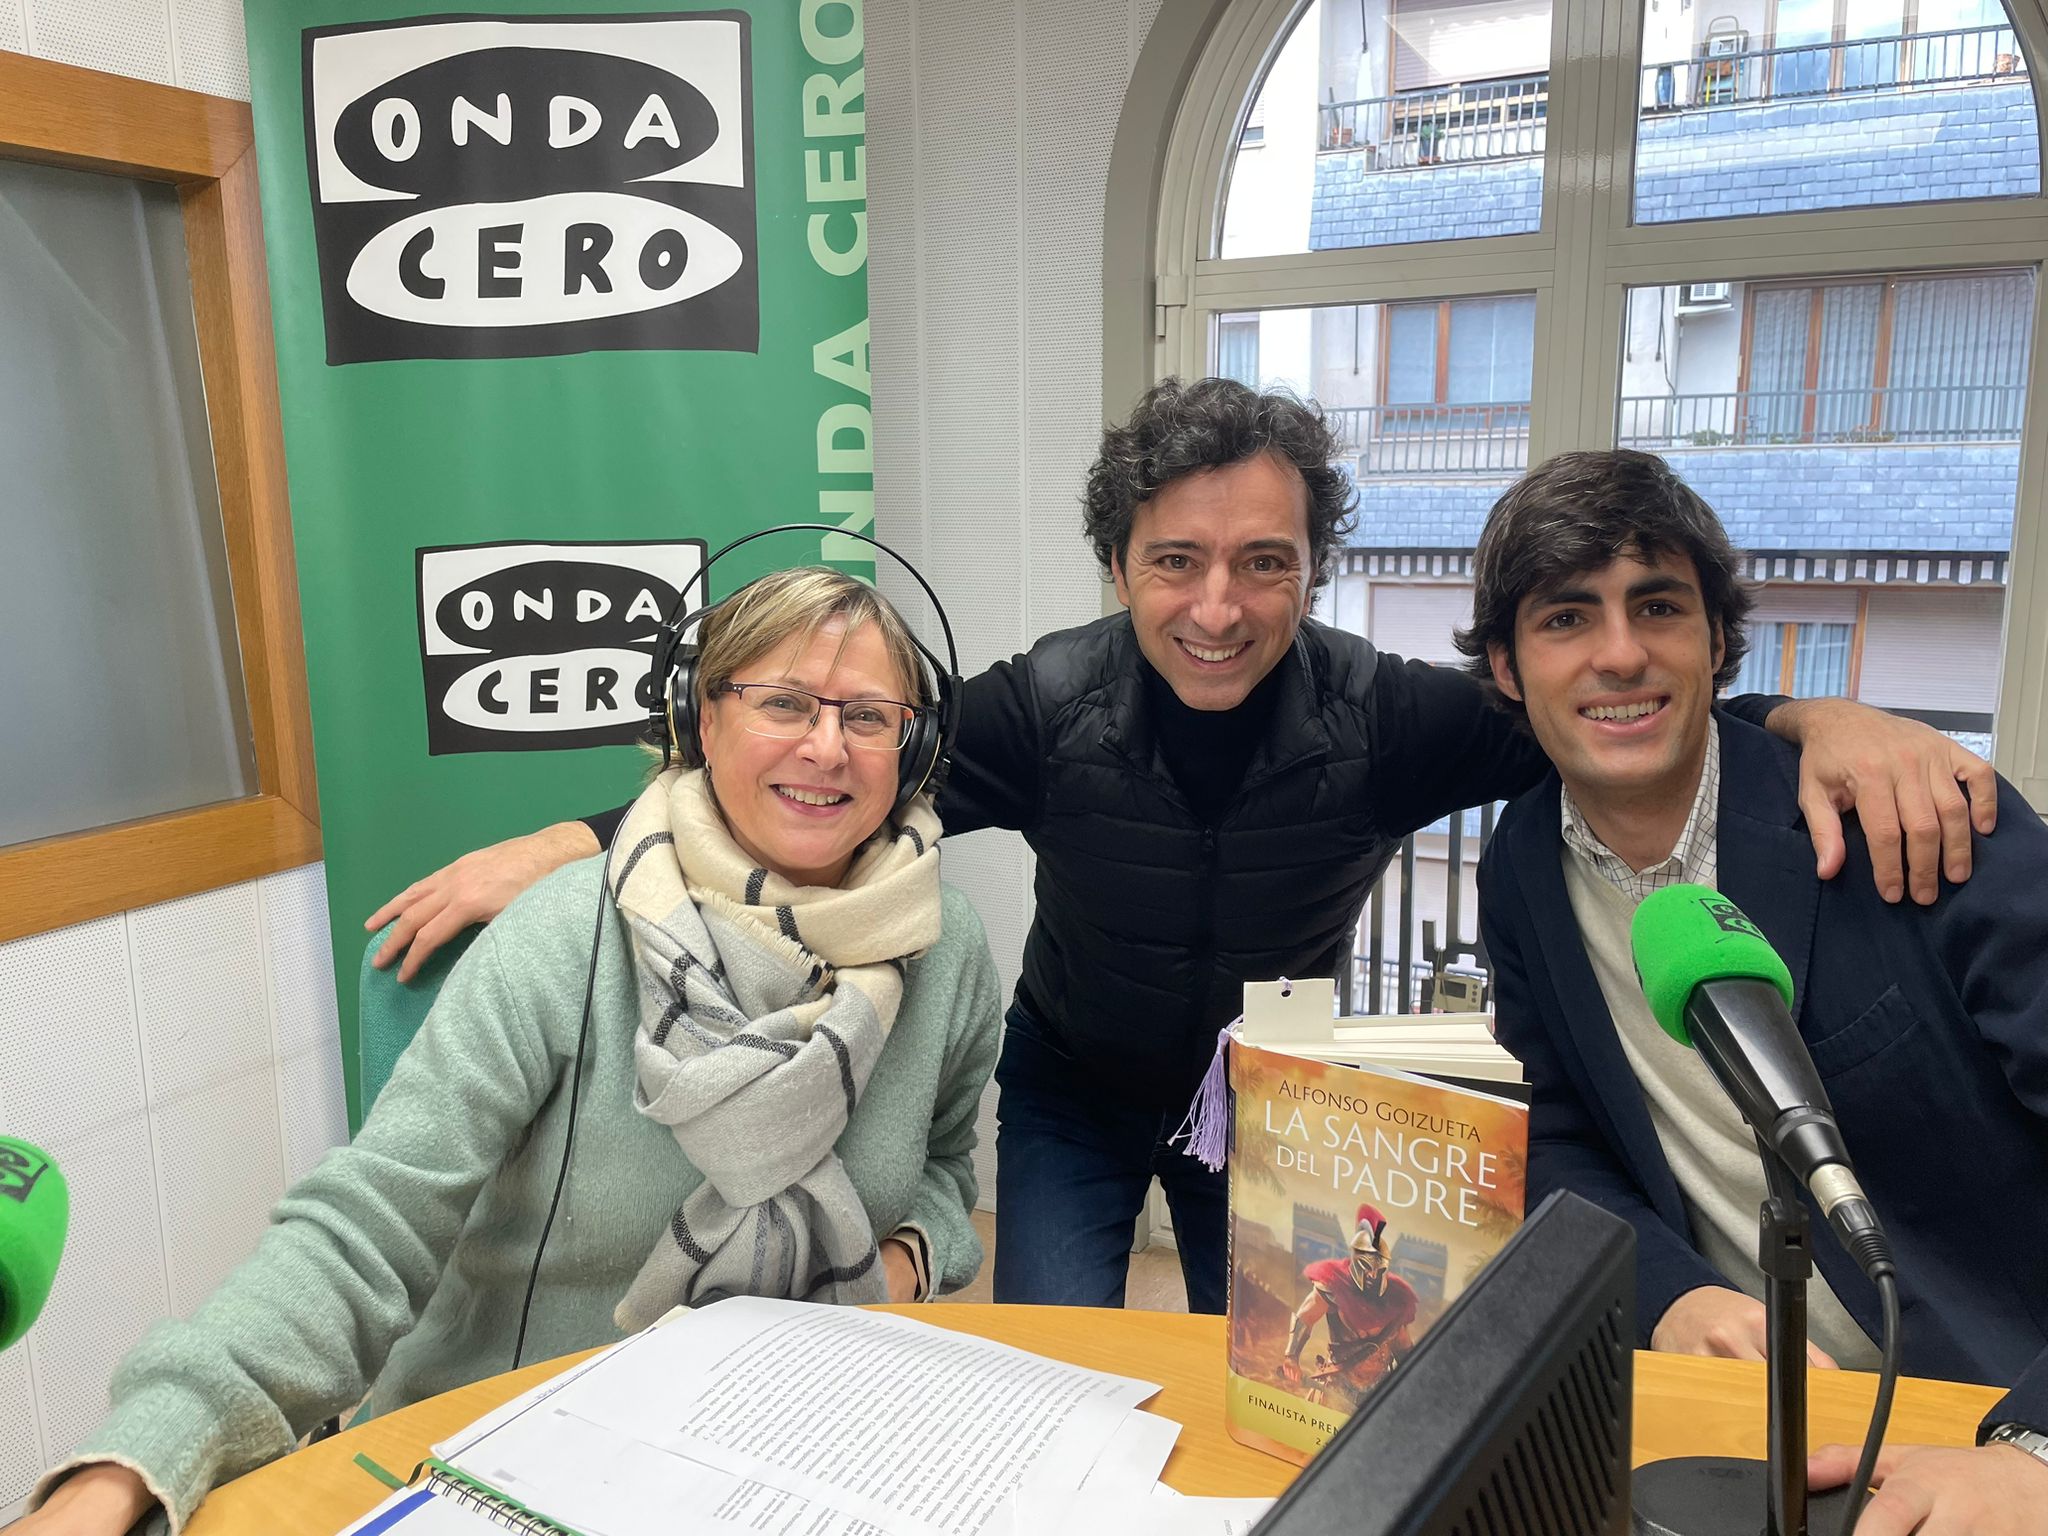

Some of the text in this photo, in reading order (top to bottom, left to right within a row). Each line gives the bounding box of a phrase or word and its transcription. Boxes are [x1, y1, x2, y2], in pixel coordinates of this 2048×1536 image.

[371, 93, 682, 162] ONDA
[398, 221, 689, 300] CERO
[799, 0, 877, 587] NDA CERO
[460, 587, 664, 632] ONDA
[1265, 1100, 1310, 1142] LA
[1322, 1115, 1497, 1189] SANGRE
[1278, 1079, 1368, 1116] ALFONSO
[1375, 1102, 1481, 1143] GOIZUETA
[1277, 1145, 1479, 1227] DEL PADRE
[1247, 1394, 1307, 1425] FINALISTA
